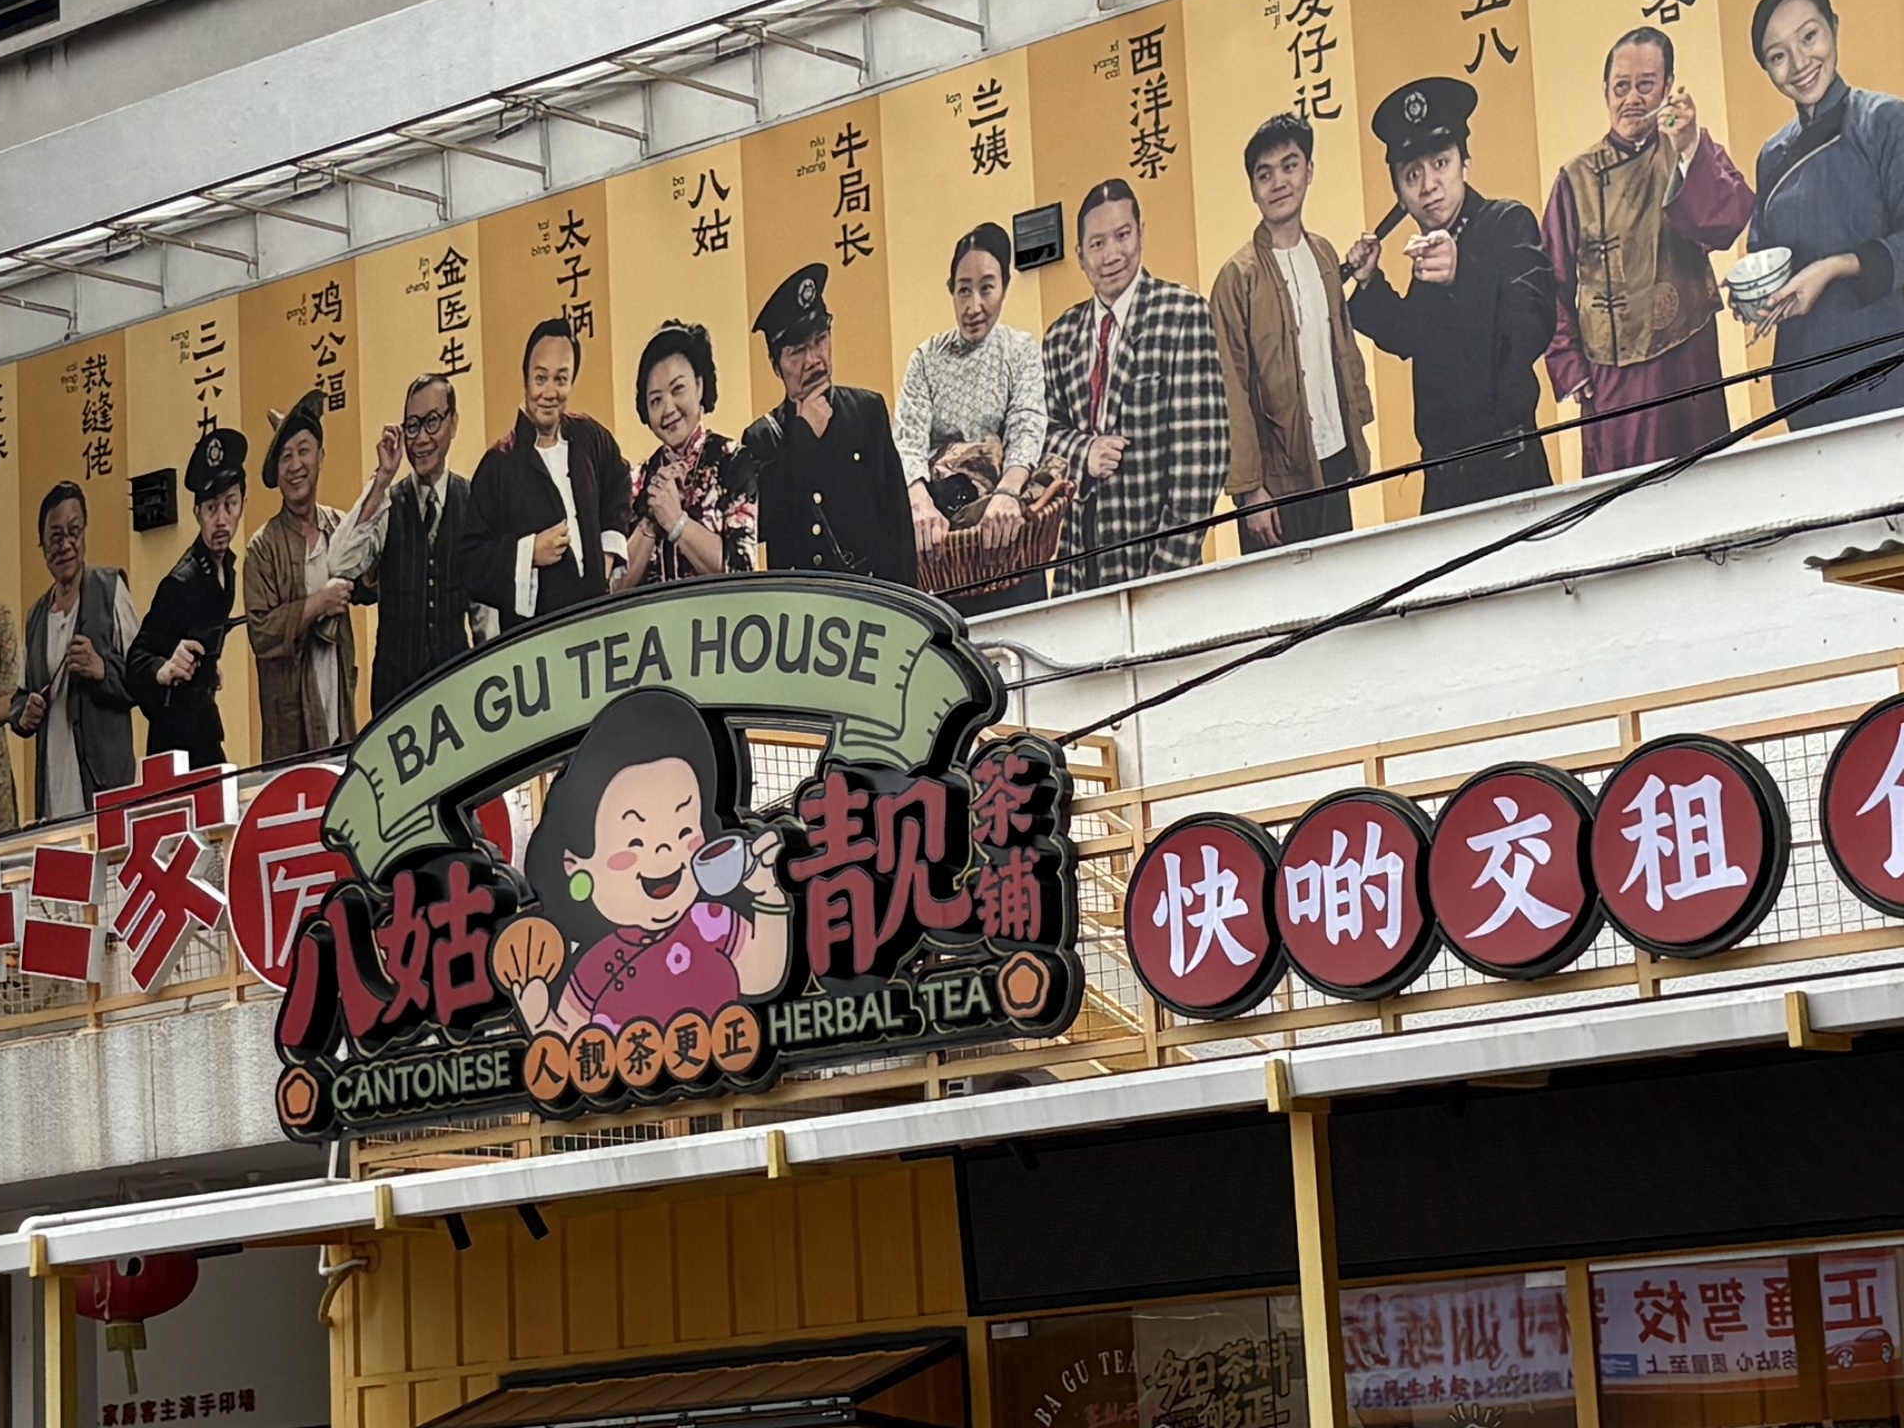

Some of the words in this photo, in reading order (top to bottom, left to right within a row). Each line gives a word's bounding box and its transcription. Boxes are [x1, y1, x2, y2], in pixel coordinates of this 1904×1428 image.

[968, 78, 1012, 176] 兰姨
[1127, 25, 1177, 178] 西洋蔡
[688, 169, 731, 257] 八姑
[832, 122, 875, 266] 牛局长
[311, 281, 346, 413] 鸡公福
[433, 246, 473, 377] 金医生
[81, 354, 113, 478] 裁缝佬
[194, 320, 228, 440] 三六九
[387, 703, 465, 786] BA
[474, 655, 551, 734] GU
[565, 623, 673, 701] TEA
[690, 611, 886, 687] HOUSE
[281, 861, 494, 1047] 八姑
[790, 771, 970, 975] 靓
[971, 752, 1042, 943] 茶铺
[1152, 775, 1749, 976] 快啲交租
[530, 1008, 758, 1088] 人靓茶更正
[769, 992, 903, 1046] HERBAL
[922, 974, 990, 1022] TEA
[331, 1049, 511, 1111] CANTONESE
